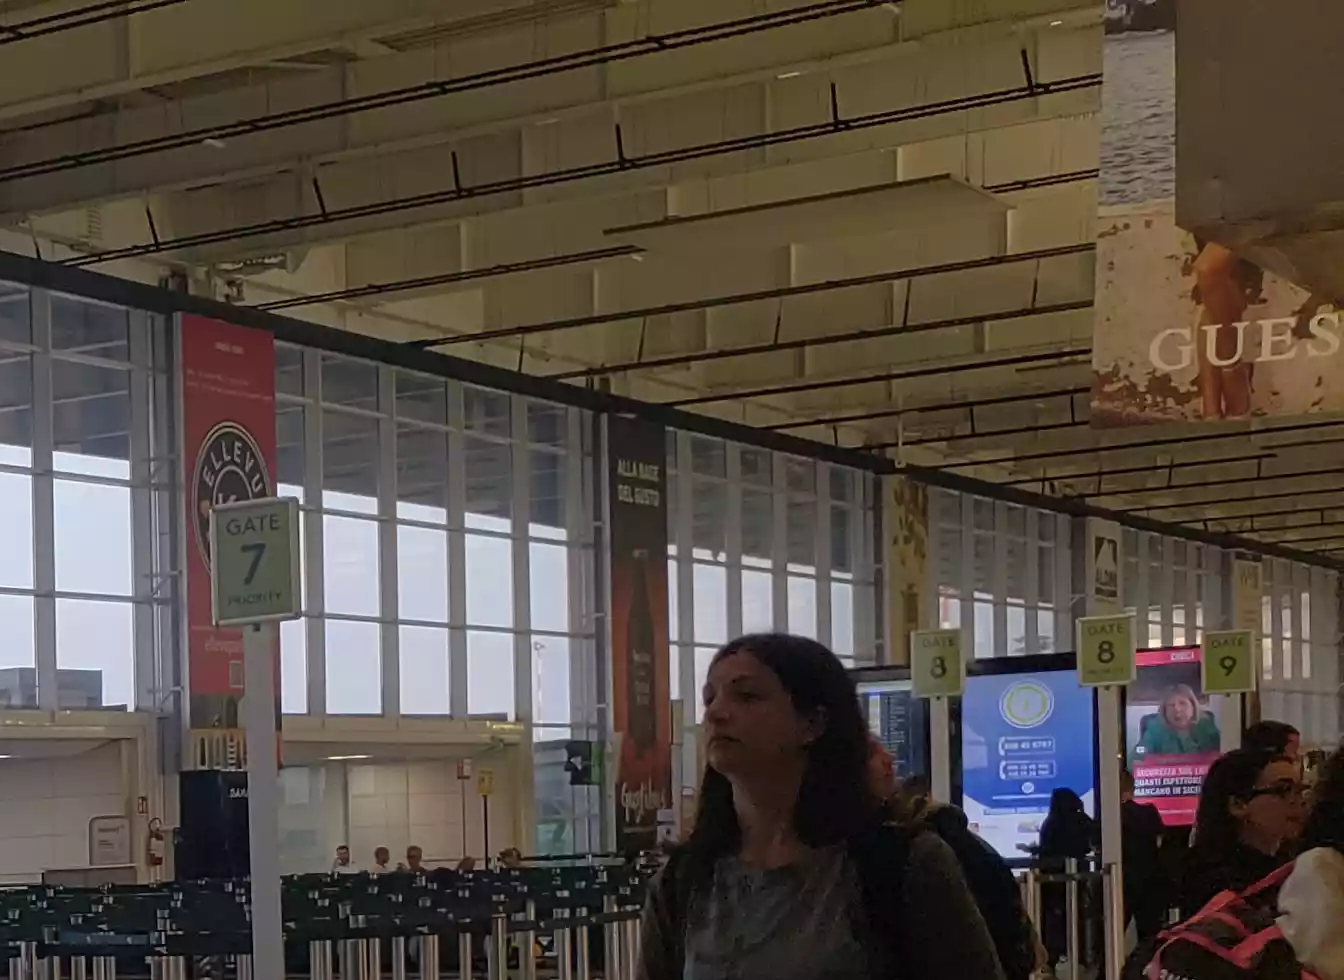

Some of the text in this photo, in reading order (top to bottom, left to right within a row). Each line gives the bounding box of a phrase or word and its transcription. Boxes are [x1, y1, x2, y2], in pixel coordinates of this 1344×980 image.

[1149, 311, 1343, 372] GUES
[225, 513, 281, 537] GATE
[240, 542, 267, 586] 7
[1097, 640, 1115, 664] 8
[1219, 655, 1237, 678] 9
